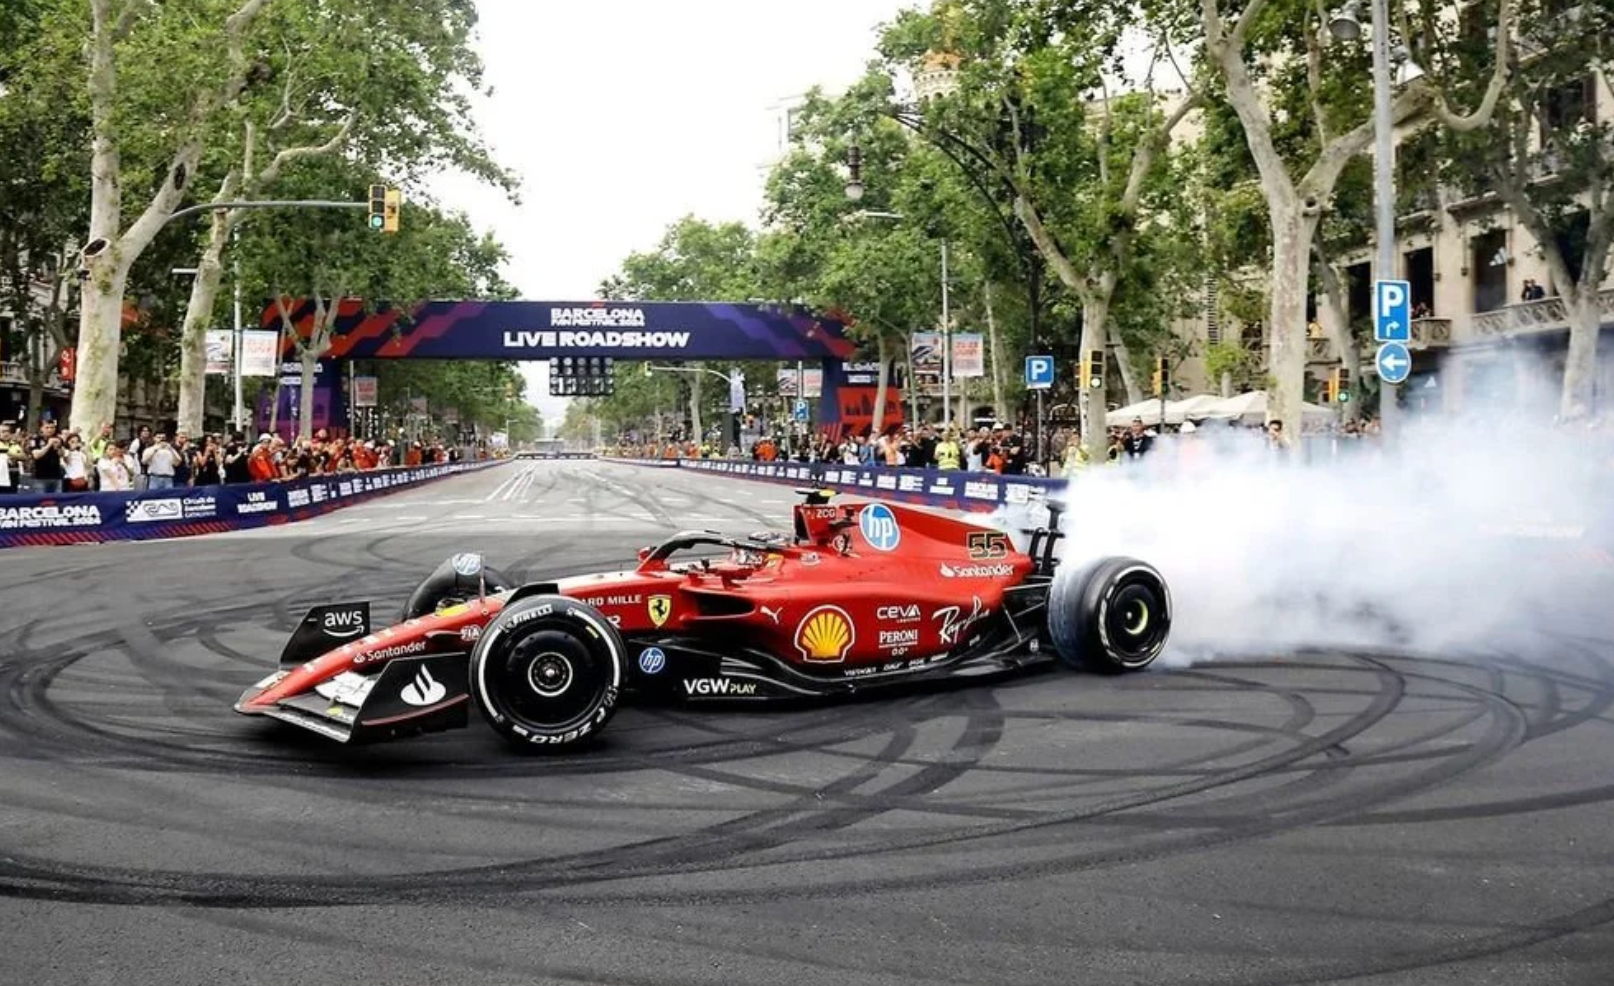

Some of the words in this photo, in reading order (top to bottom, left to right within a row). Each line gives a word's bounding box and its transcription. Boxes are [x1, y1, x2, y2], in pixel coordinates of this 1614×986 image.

[1381, 284, 1404, 317] P
[551, 307, 645, 319] BARCELONA
[504, 331, 556, 347] LIVE
[558, 331, 690, 347] ROADSHOW
[1030, 360, 1048, 380] P
[796, 401, 806, 412] P
[967, 532, 1007, 559] 55
[953, 564, 1014, 578] Santander
[607, 594, 642, 605] MILLE
[324, 610, 363, 627] aws
[512, 604, 553, 627] PIRELLI
[879, 629, 918, 643] PERONI
[367, 640, 427, 662] Santander
[640, 647, 665, 674] hp
[683, 678, 730, 695] VGW
[729, 684, 757, 695] PLAY
[529, 721, 592, 744] ZERO
